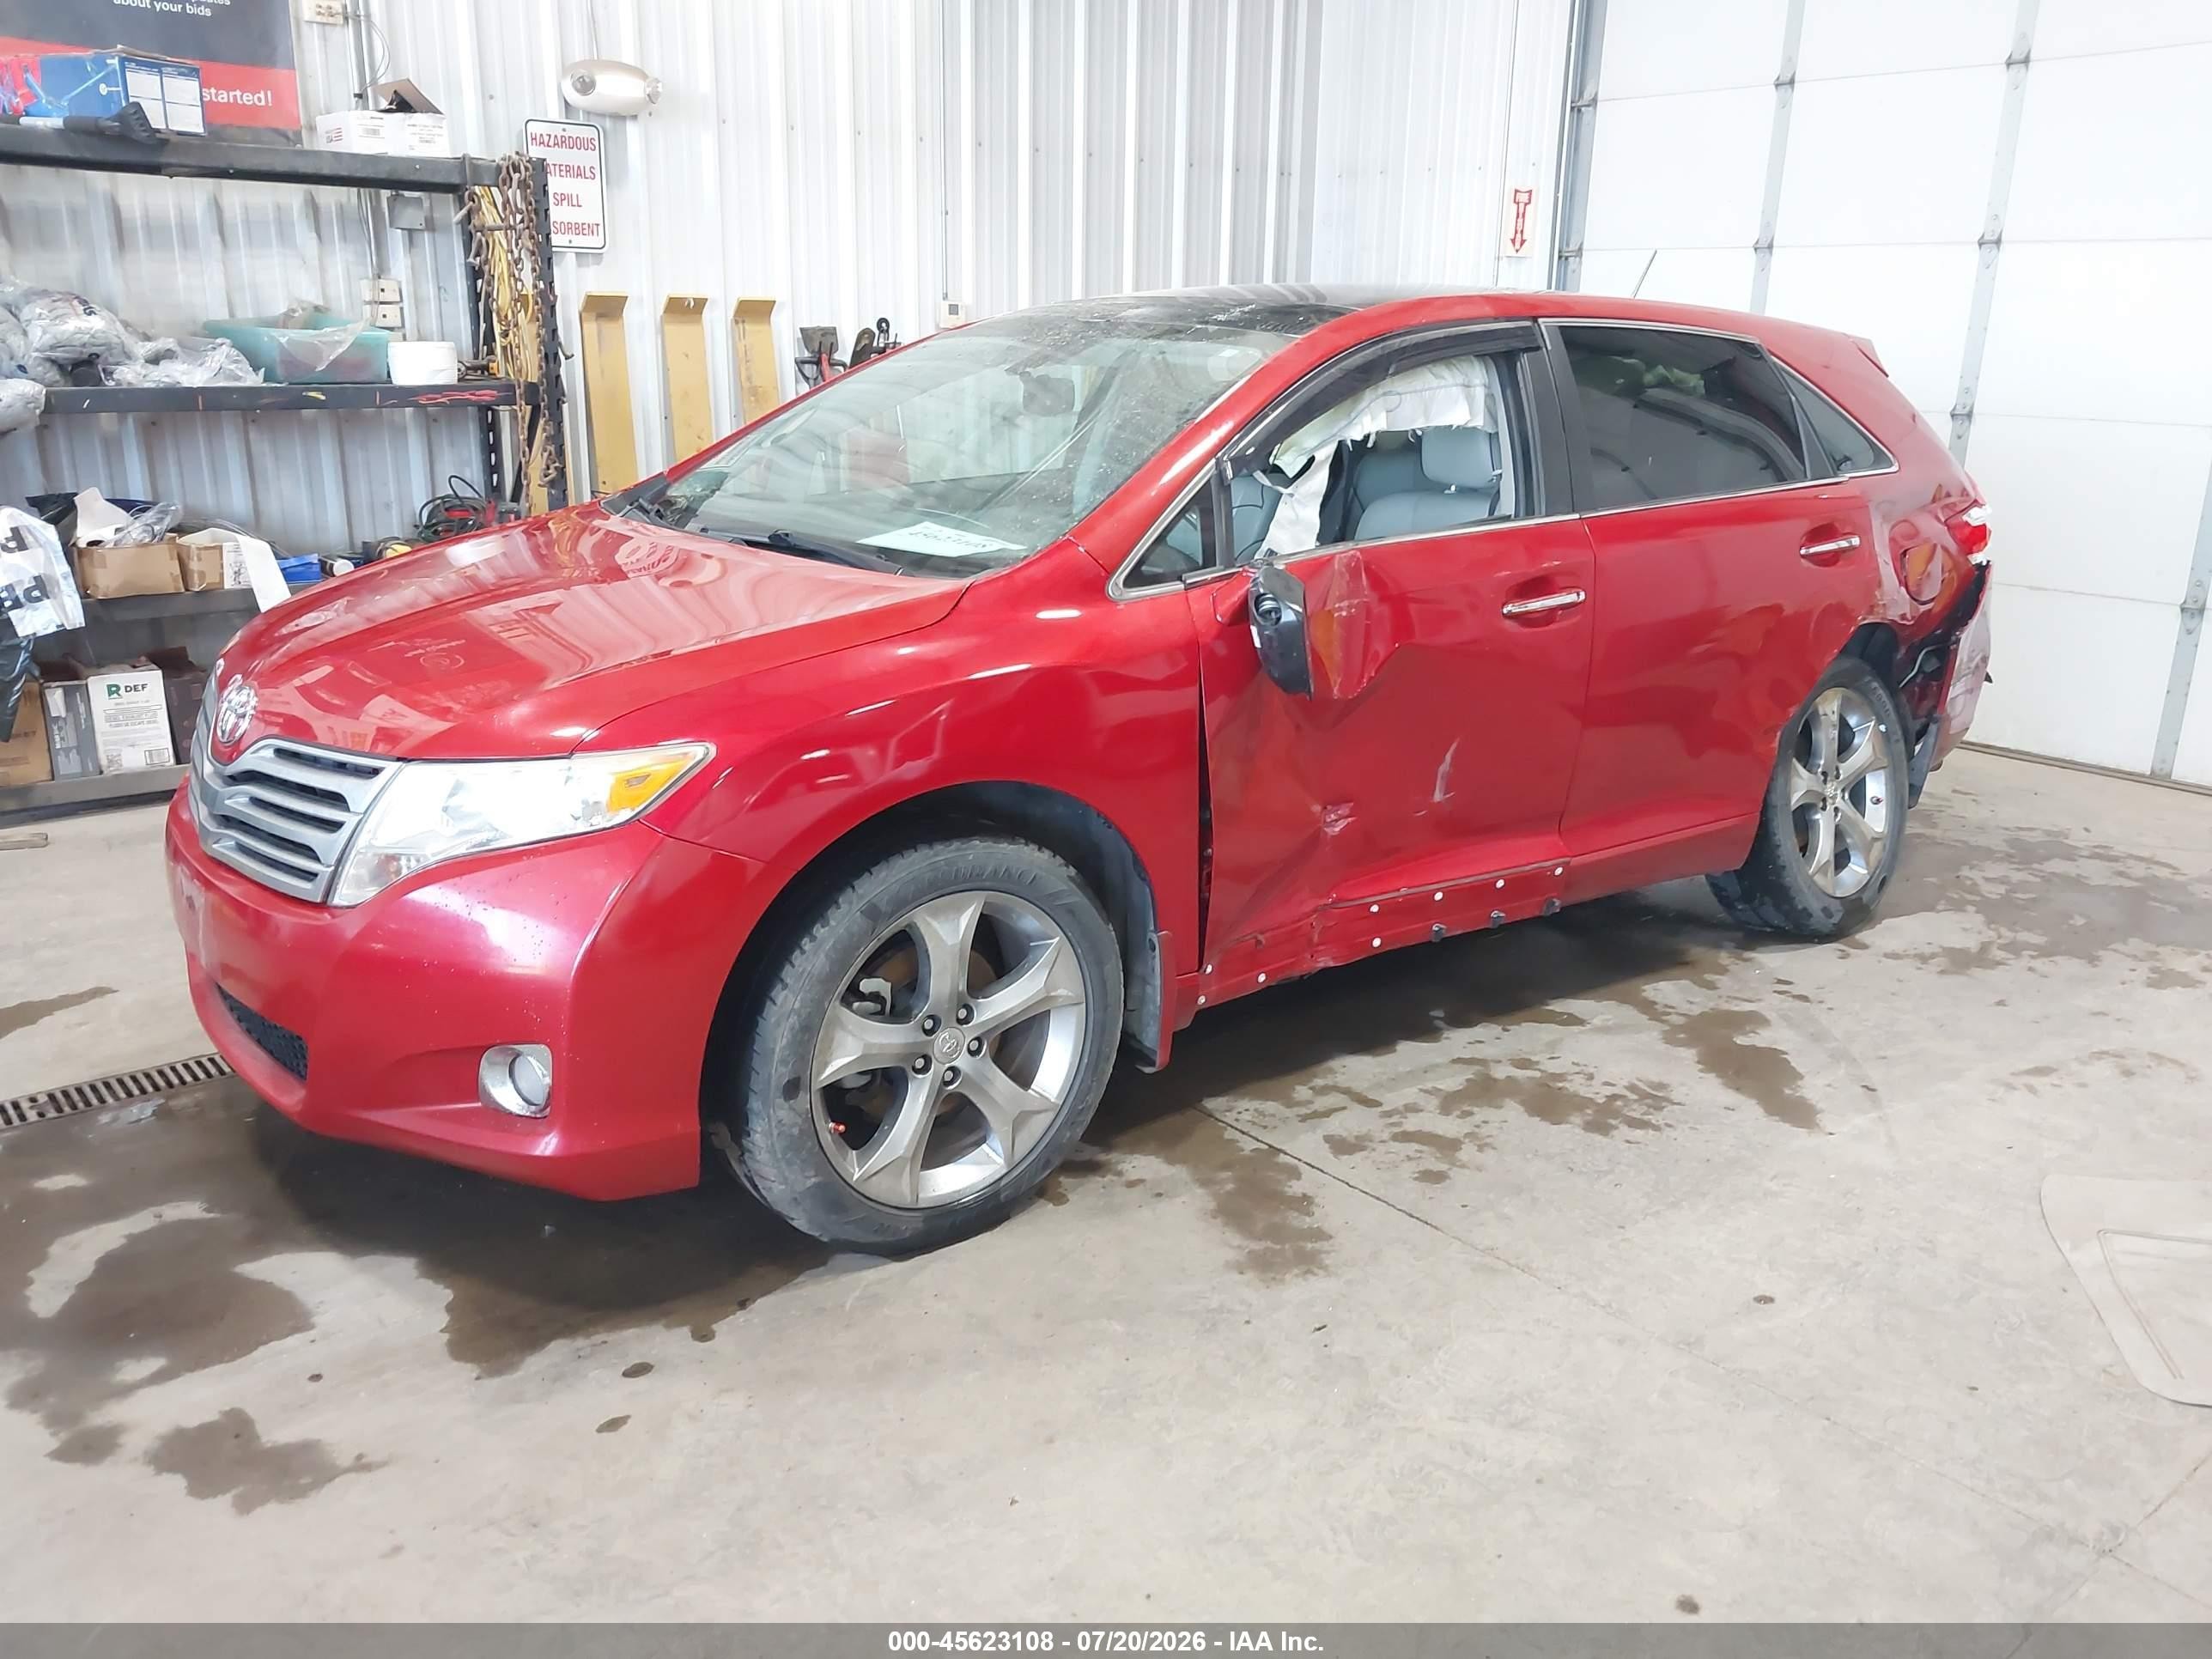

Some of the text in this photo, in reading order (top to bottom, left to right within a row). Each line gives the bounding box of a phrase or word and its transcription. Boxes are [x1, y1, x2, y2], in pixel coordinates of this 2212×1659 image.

[112, 0, 212, 16] about your bids
[202, 87, 272, 106] started!
[530, 132, 597, 152] HAZARDOUS
[552, 191, 583, 208] SPILL
[552, 221, 600, 237] SORBENT
[125, 684, 149, 693] DEF
